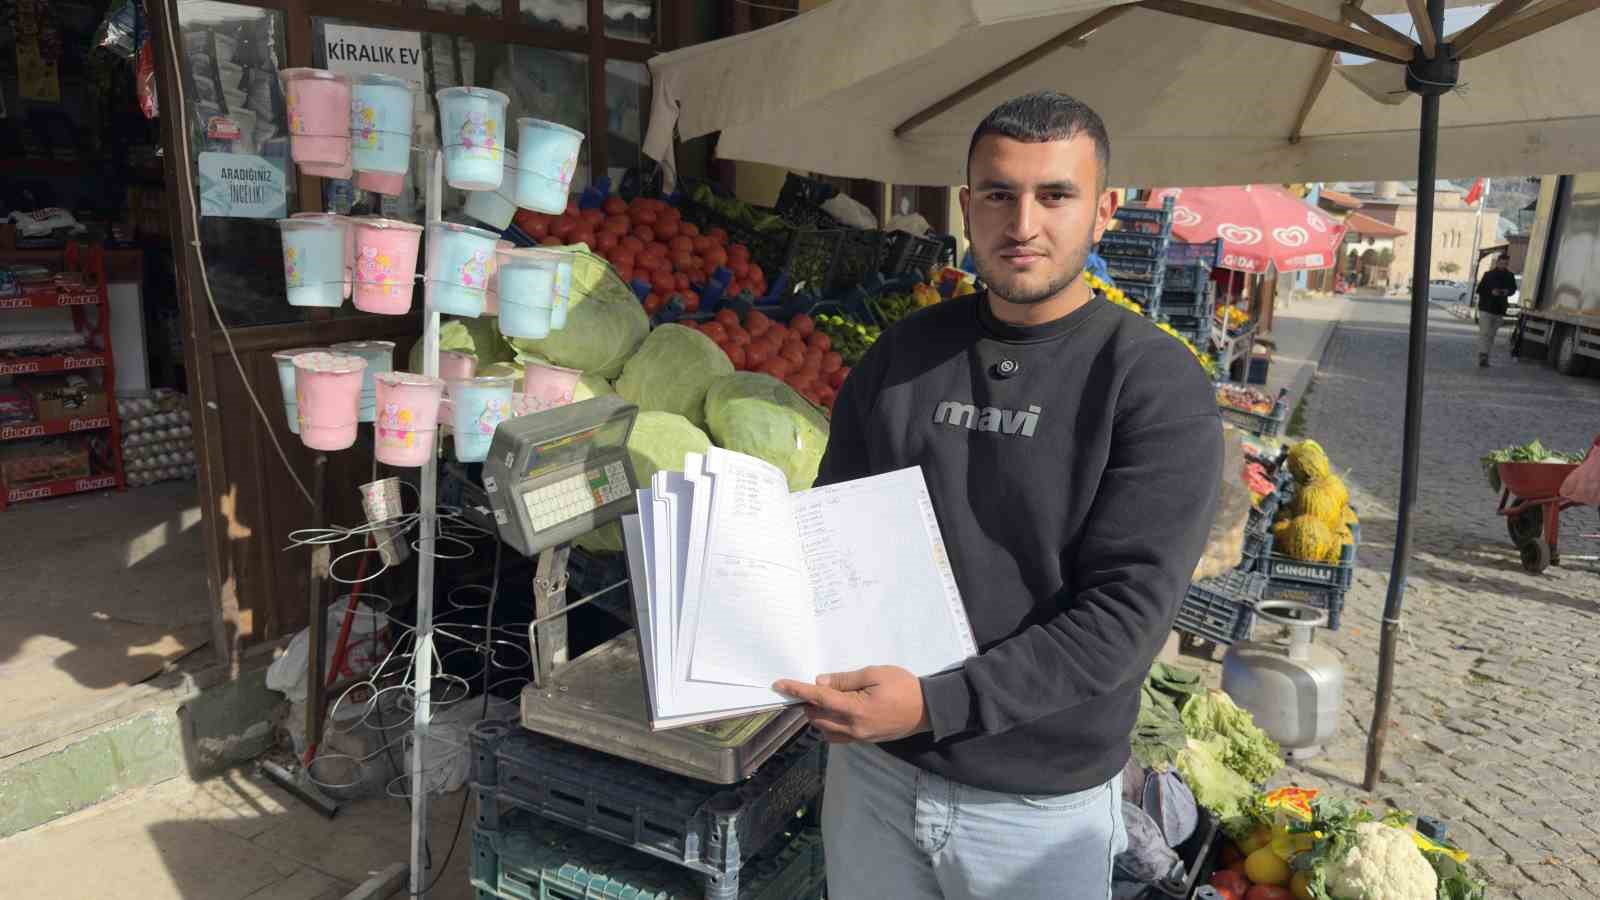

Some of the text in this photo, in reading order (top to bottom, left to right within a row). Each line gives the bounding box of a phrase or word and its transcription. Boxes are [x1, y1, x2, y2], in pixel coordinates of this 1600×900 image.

[327, 38, 420, 65] KİRALIK EV
[933, 401, 1041, 437] mavi
